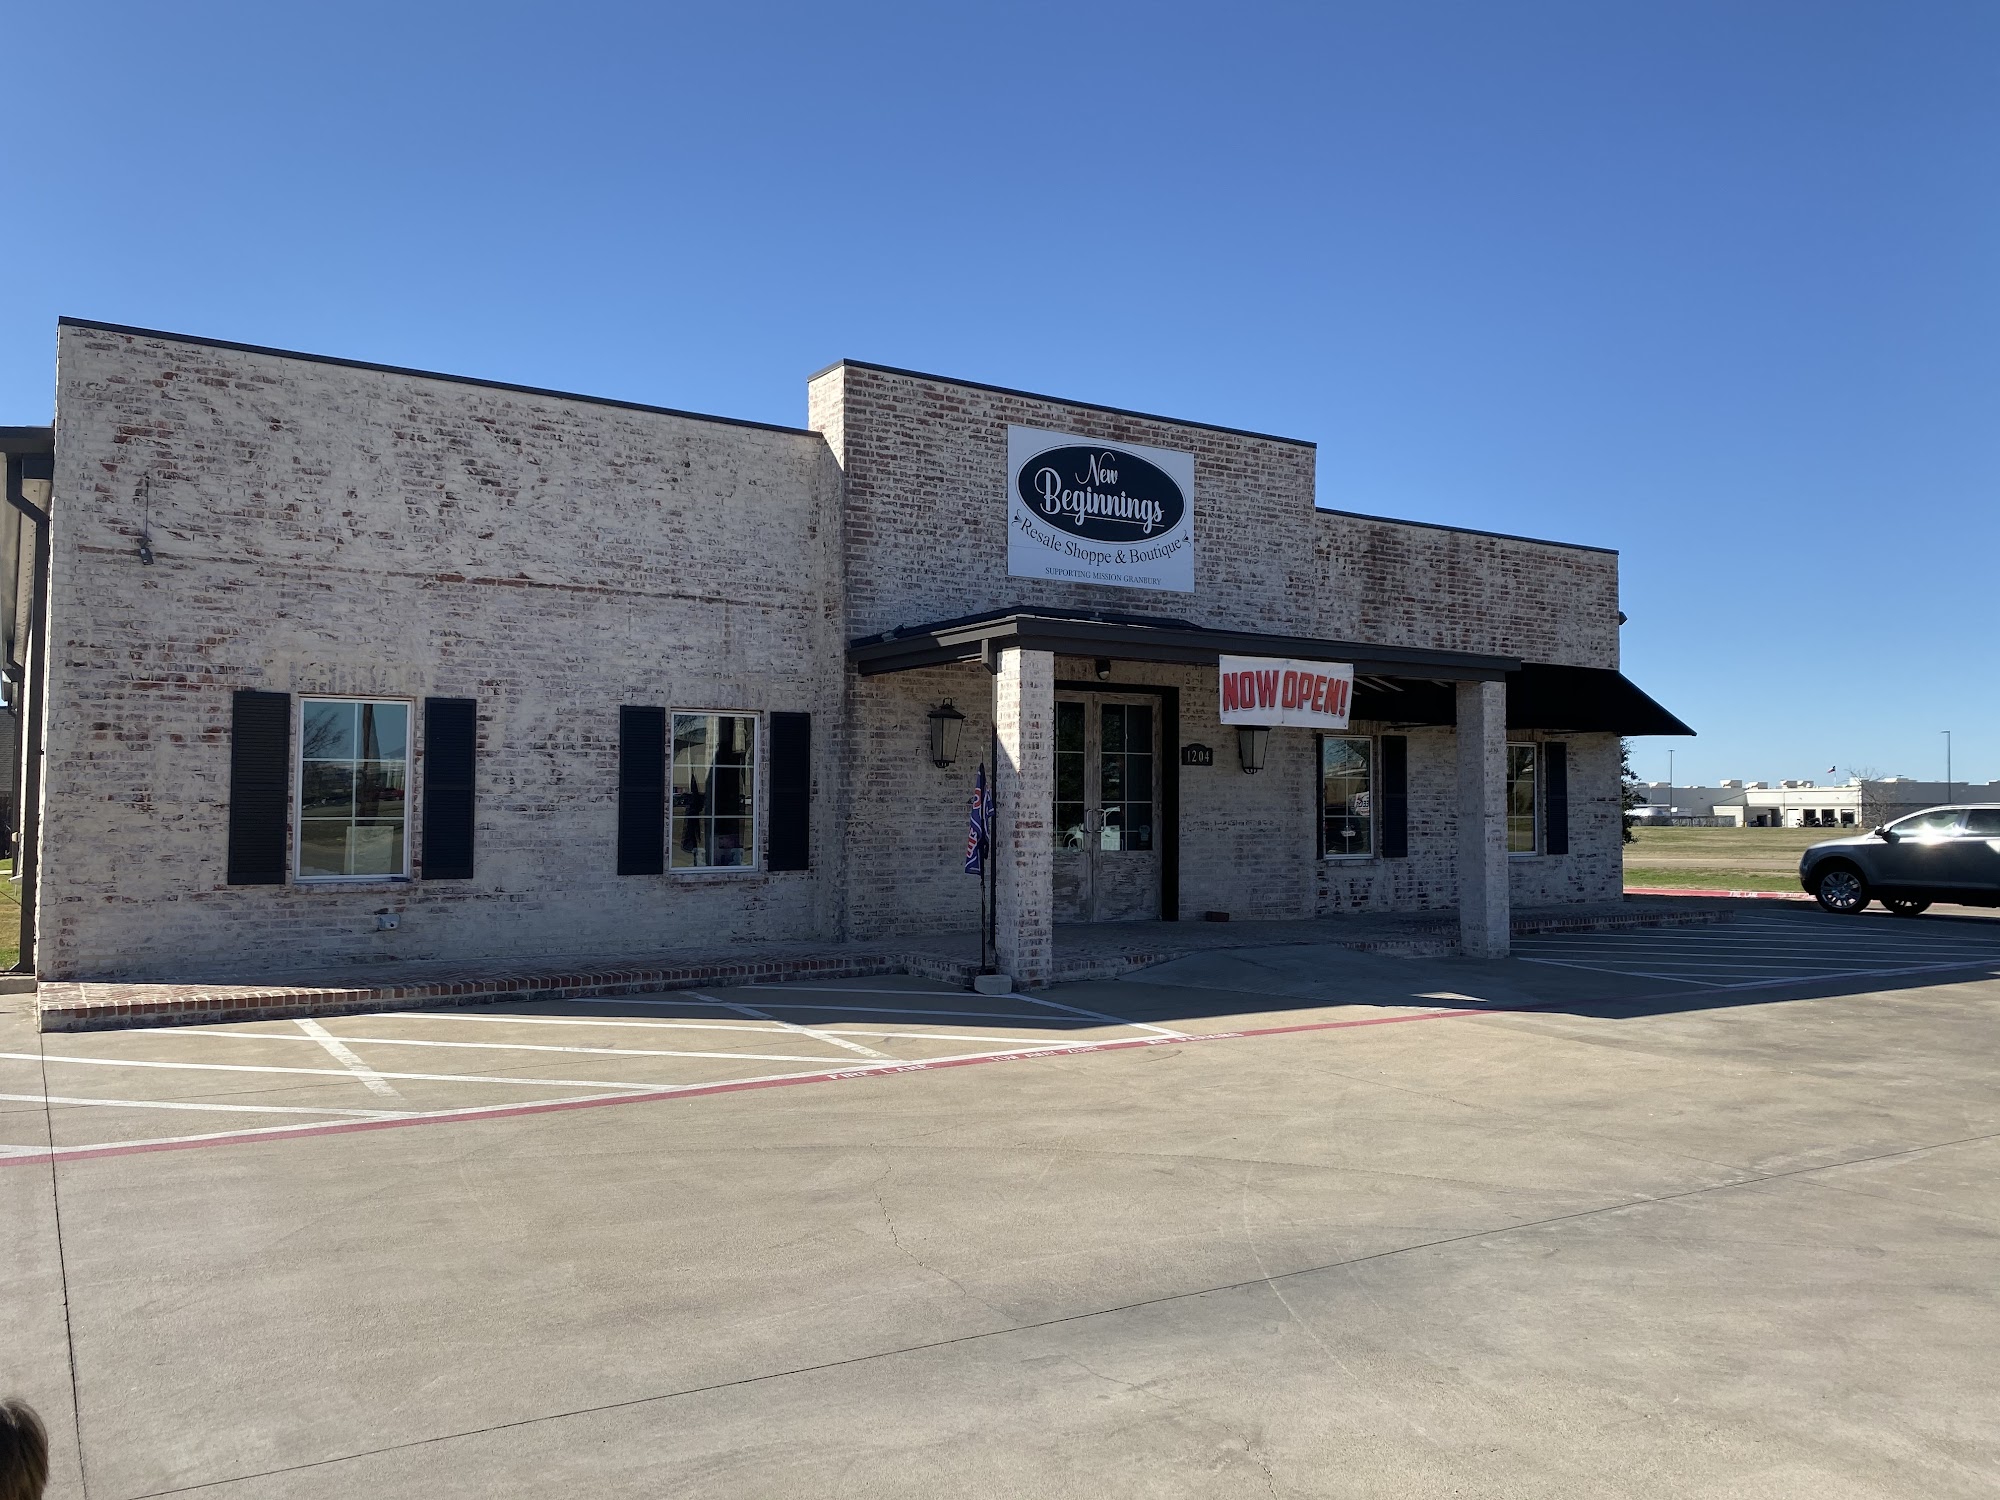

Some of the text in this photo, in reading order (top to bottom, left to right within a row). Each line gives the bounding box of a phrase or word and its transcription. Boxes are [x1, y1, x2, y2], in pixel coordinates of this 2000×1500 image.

[1075, 451, 1118, 486] New
[1034, 467, 1165, 534] Beginnings
[1020, 517, 1182, 567] Resale Shoppe & Boutique
[1045, 567, 1162, 586] SUPPORTING MISSION GRANBURY
[1223, 669, 1349, 717] NOW OPEN!
[1186, 749, 1210, 763] 1204
[826, 1064, 933, 1080] FIRE LANE
